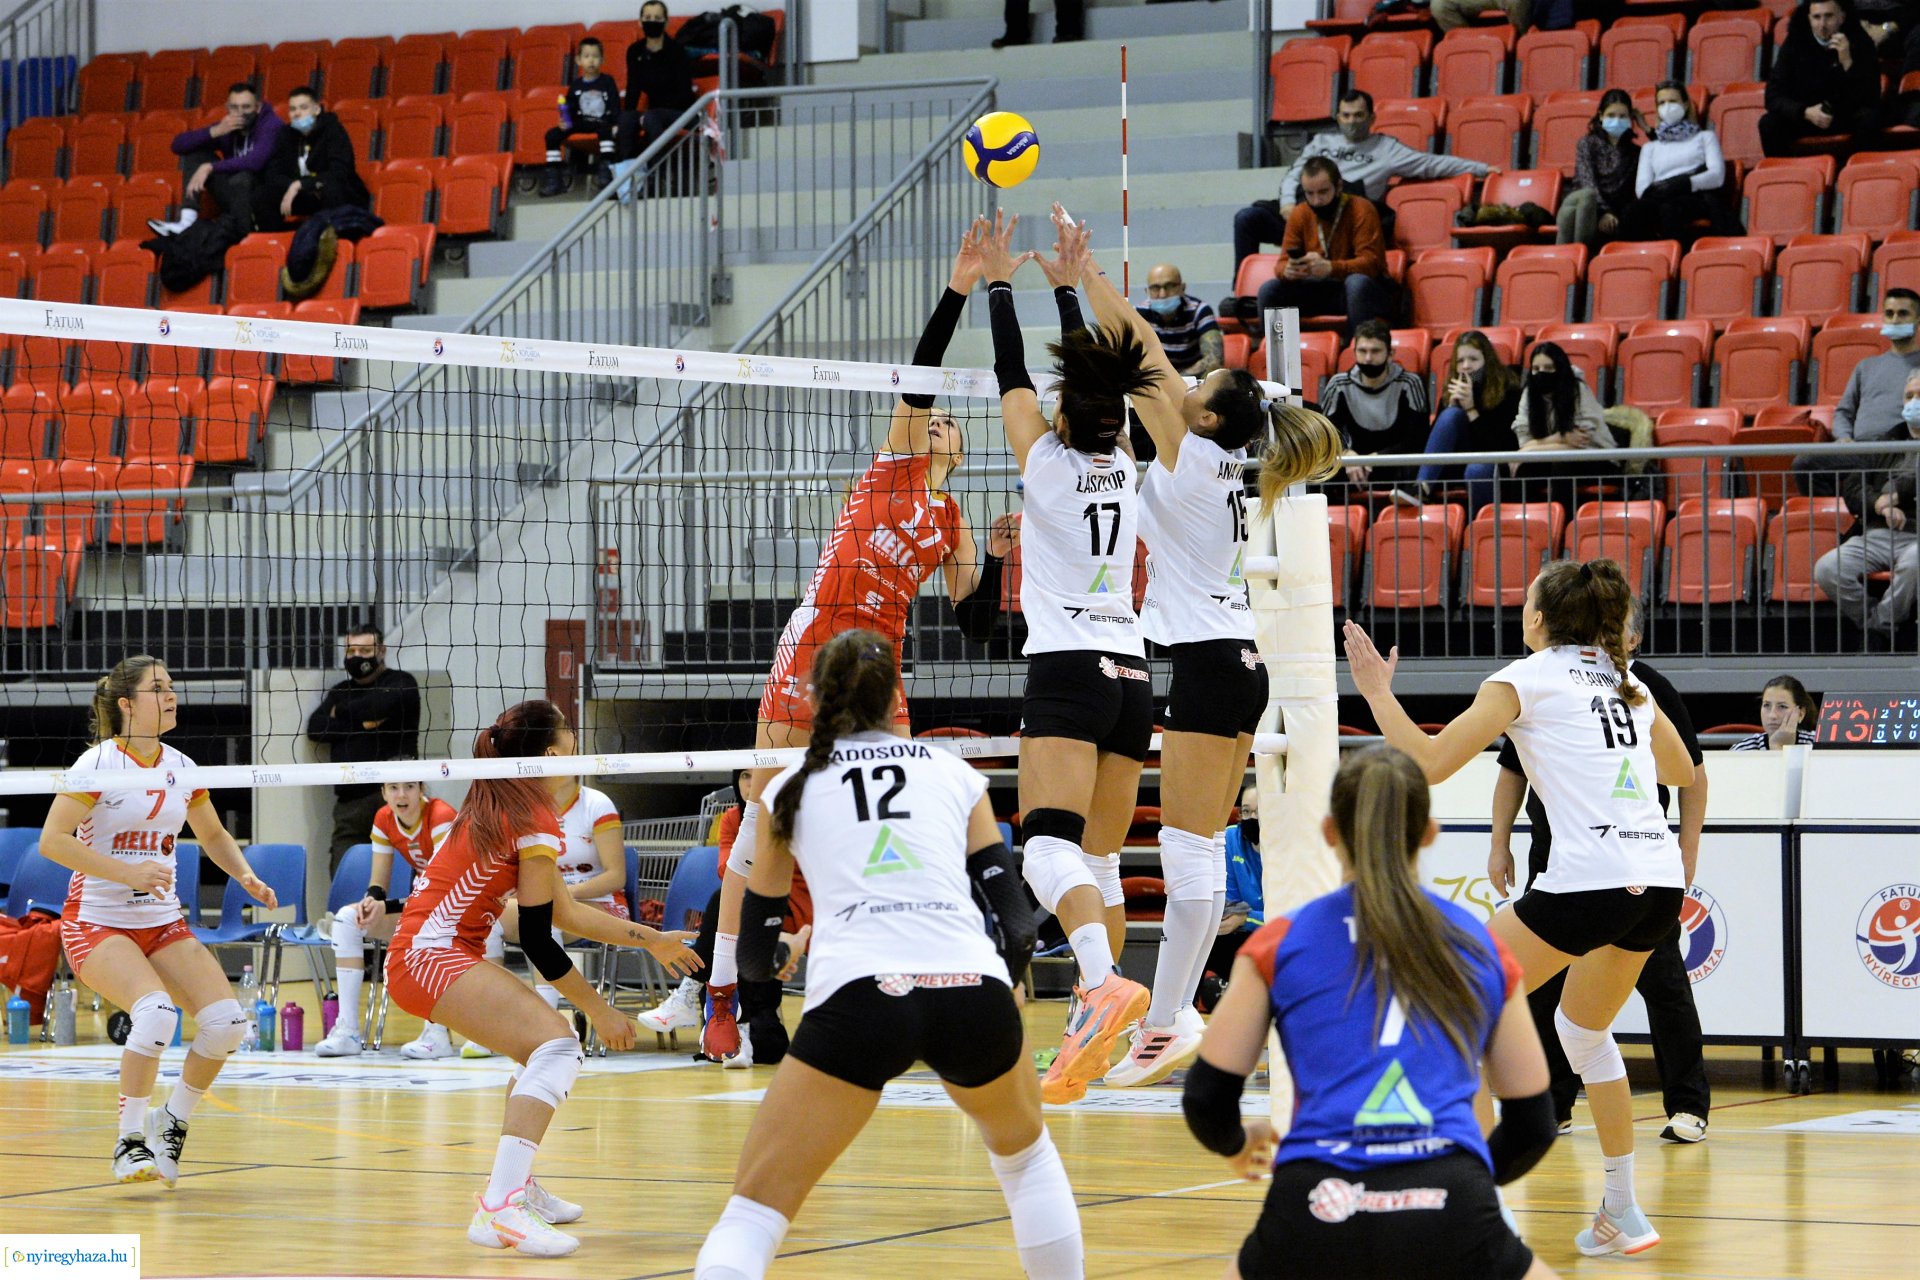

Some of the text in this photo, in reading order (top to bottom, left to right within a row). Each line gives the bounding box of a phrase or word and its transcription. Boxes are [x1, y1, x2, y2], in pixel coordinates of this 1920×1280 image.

[45, 309, 84, 330] FATUM
[334, 331, 369, 350] FATUM
[588, 350, 619, 368] FATUM
[813, 365, 840, 382] FATUM
[1226, 489, 1249, 543] 15
[1083, 501, 1121, 556] 17
[1089, 614, 1135, 625] BESTRONG
[1590, 695, 1638, 750] 19
[830, 744, 933, 763] ADOSOVA
[252, 769, 282, 784] FATUM
[516, 761, 544, 775] FATUM
[841, 764, 912, 822] 12
[146, 789, 166, 820] 7
[112, 831, 160, 851] HELL
[1880, 886, 1920, 902] FATU
[869, 901, 960, 914] BESTRONG
[1863, 953, 1920, 988] NYÍREGY
